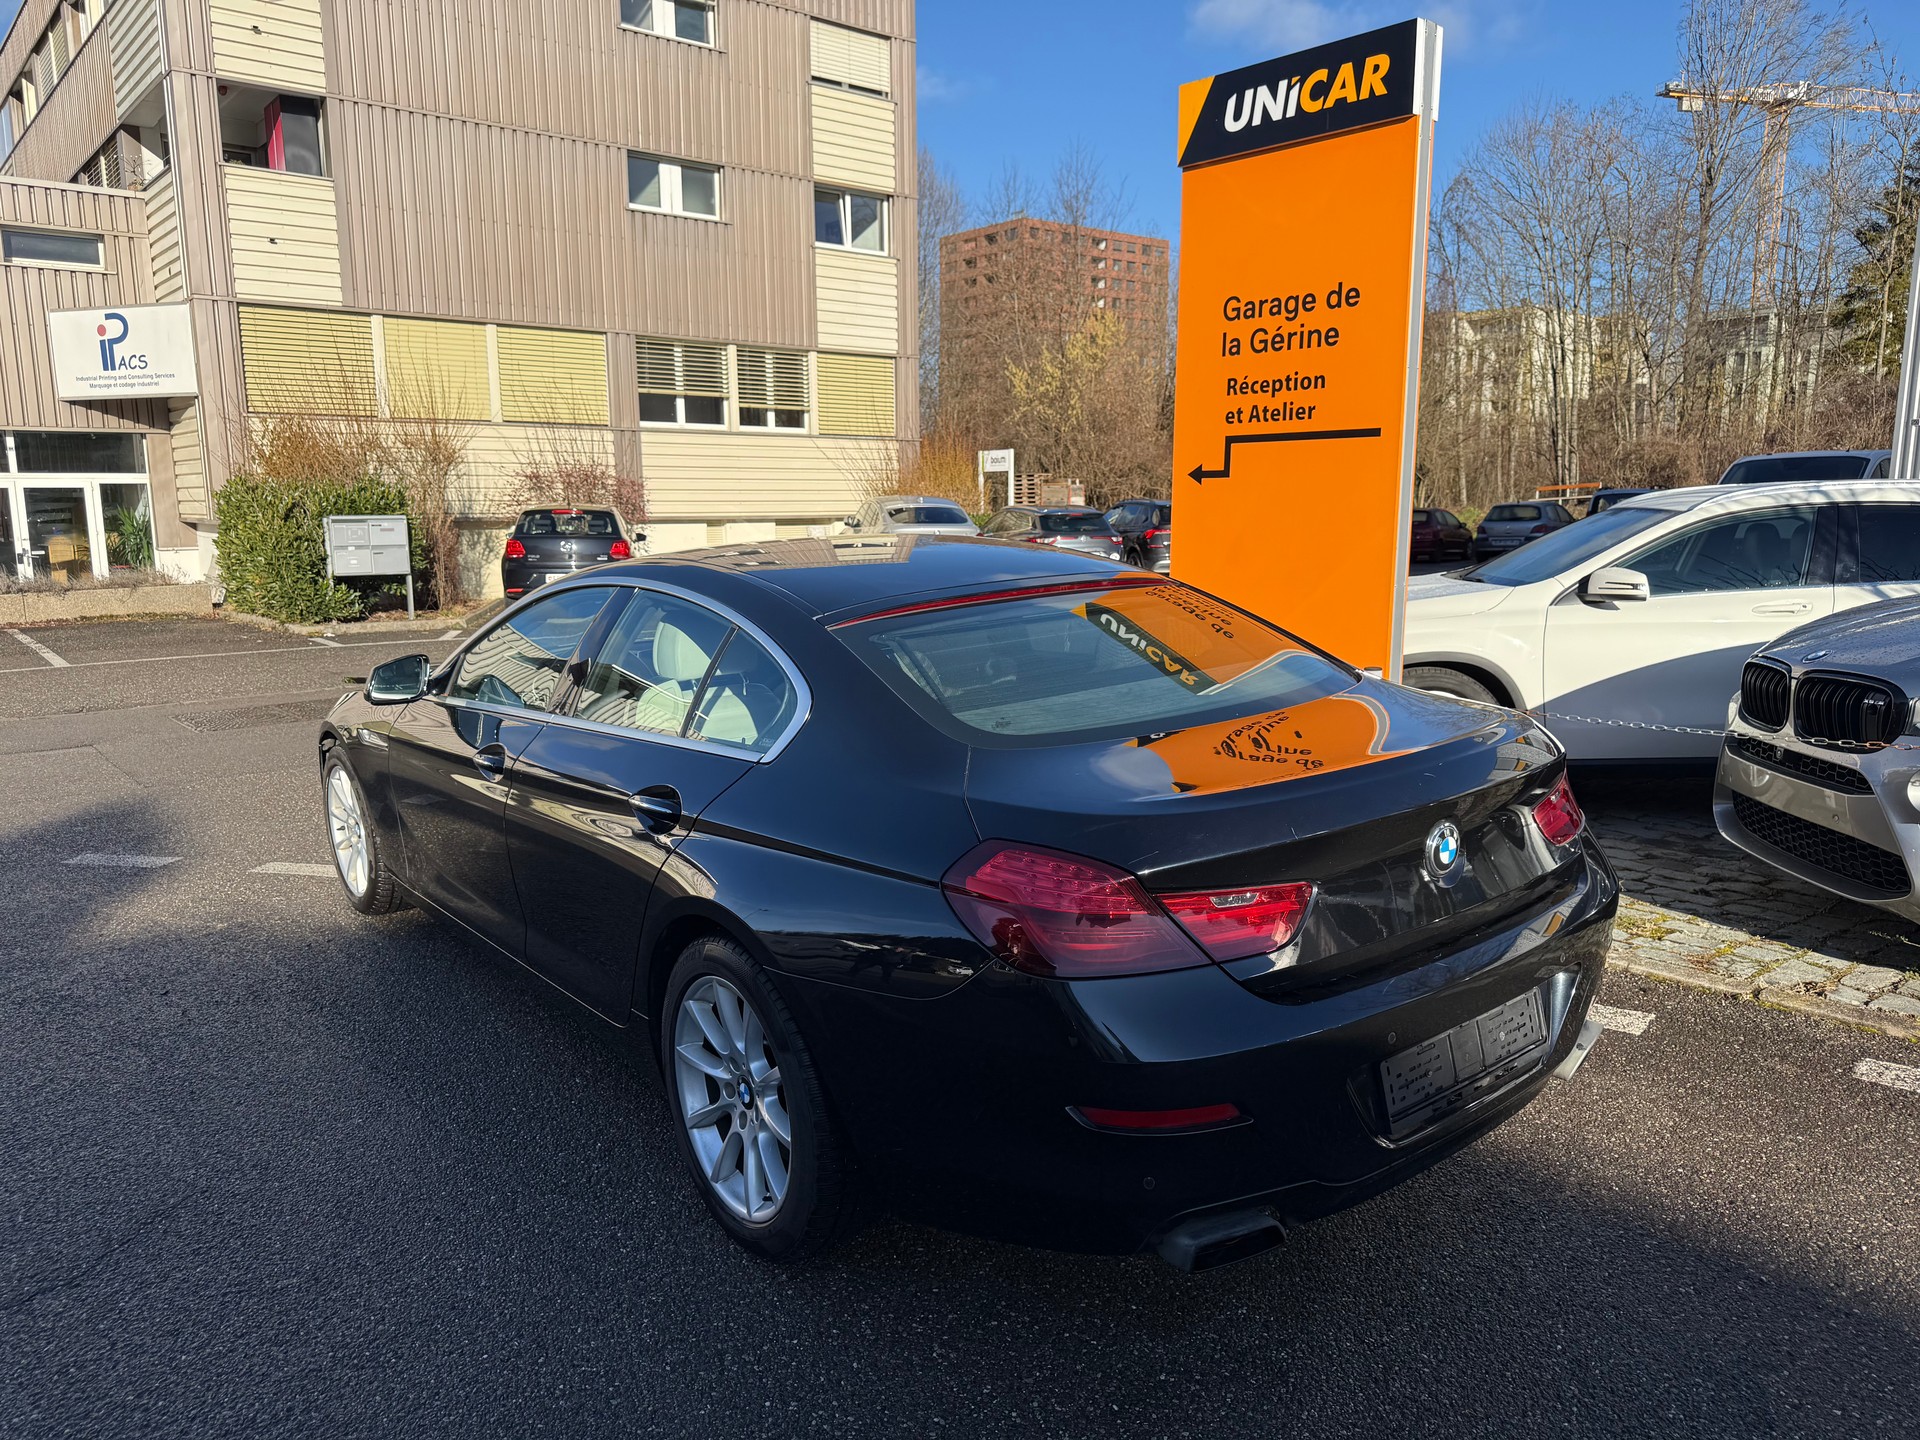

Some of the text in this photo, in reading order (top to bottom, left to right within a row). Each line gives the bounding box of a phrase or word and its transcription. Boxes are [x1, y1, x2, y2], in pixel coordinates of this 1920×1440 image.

[1223, 281, 1361, 322] Garage de
[1222, 323, 1340, 357] la Gérine
[1226, 371, 1326, 398] Réception
[1225, 401, 1316, 424] et Atelier
